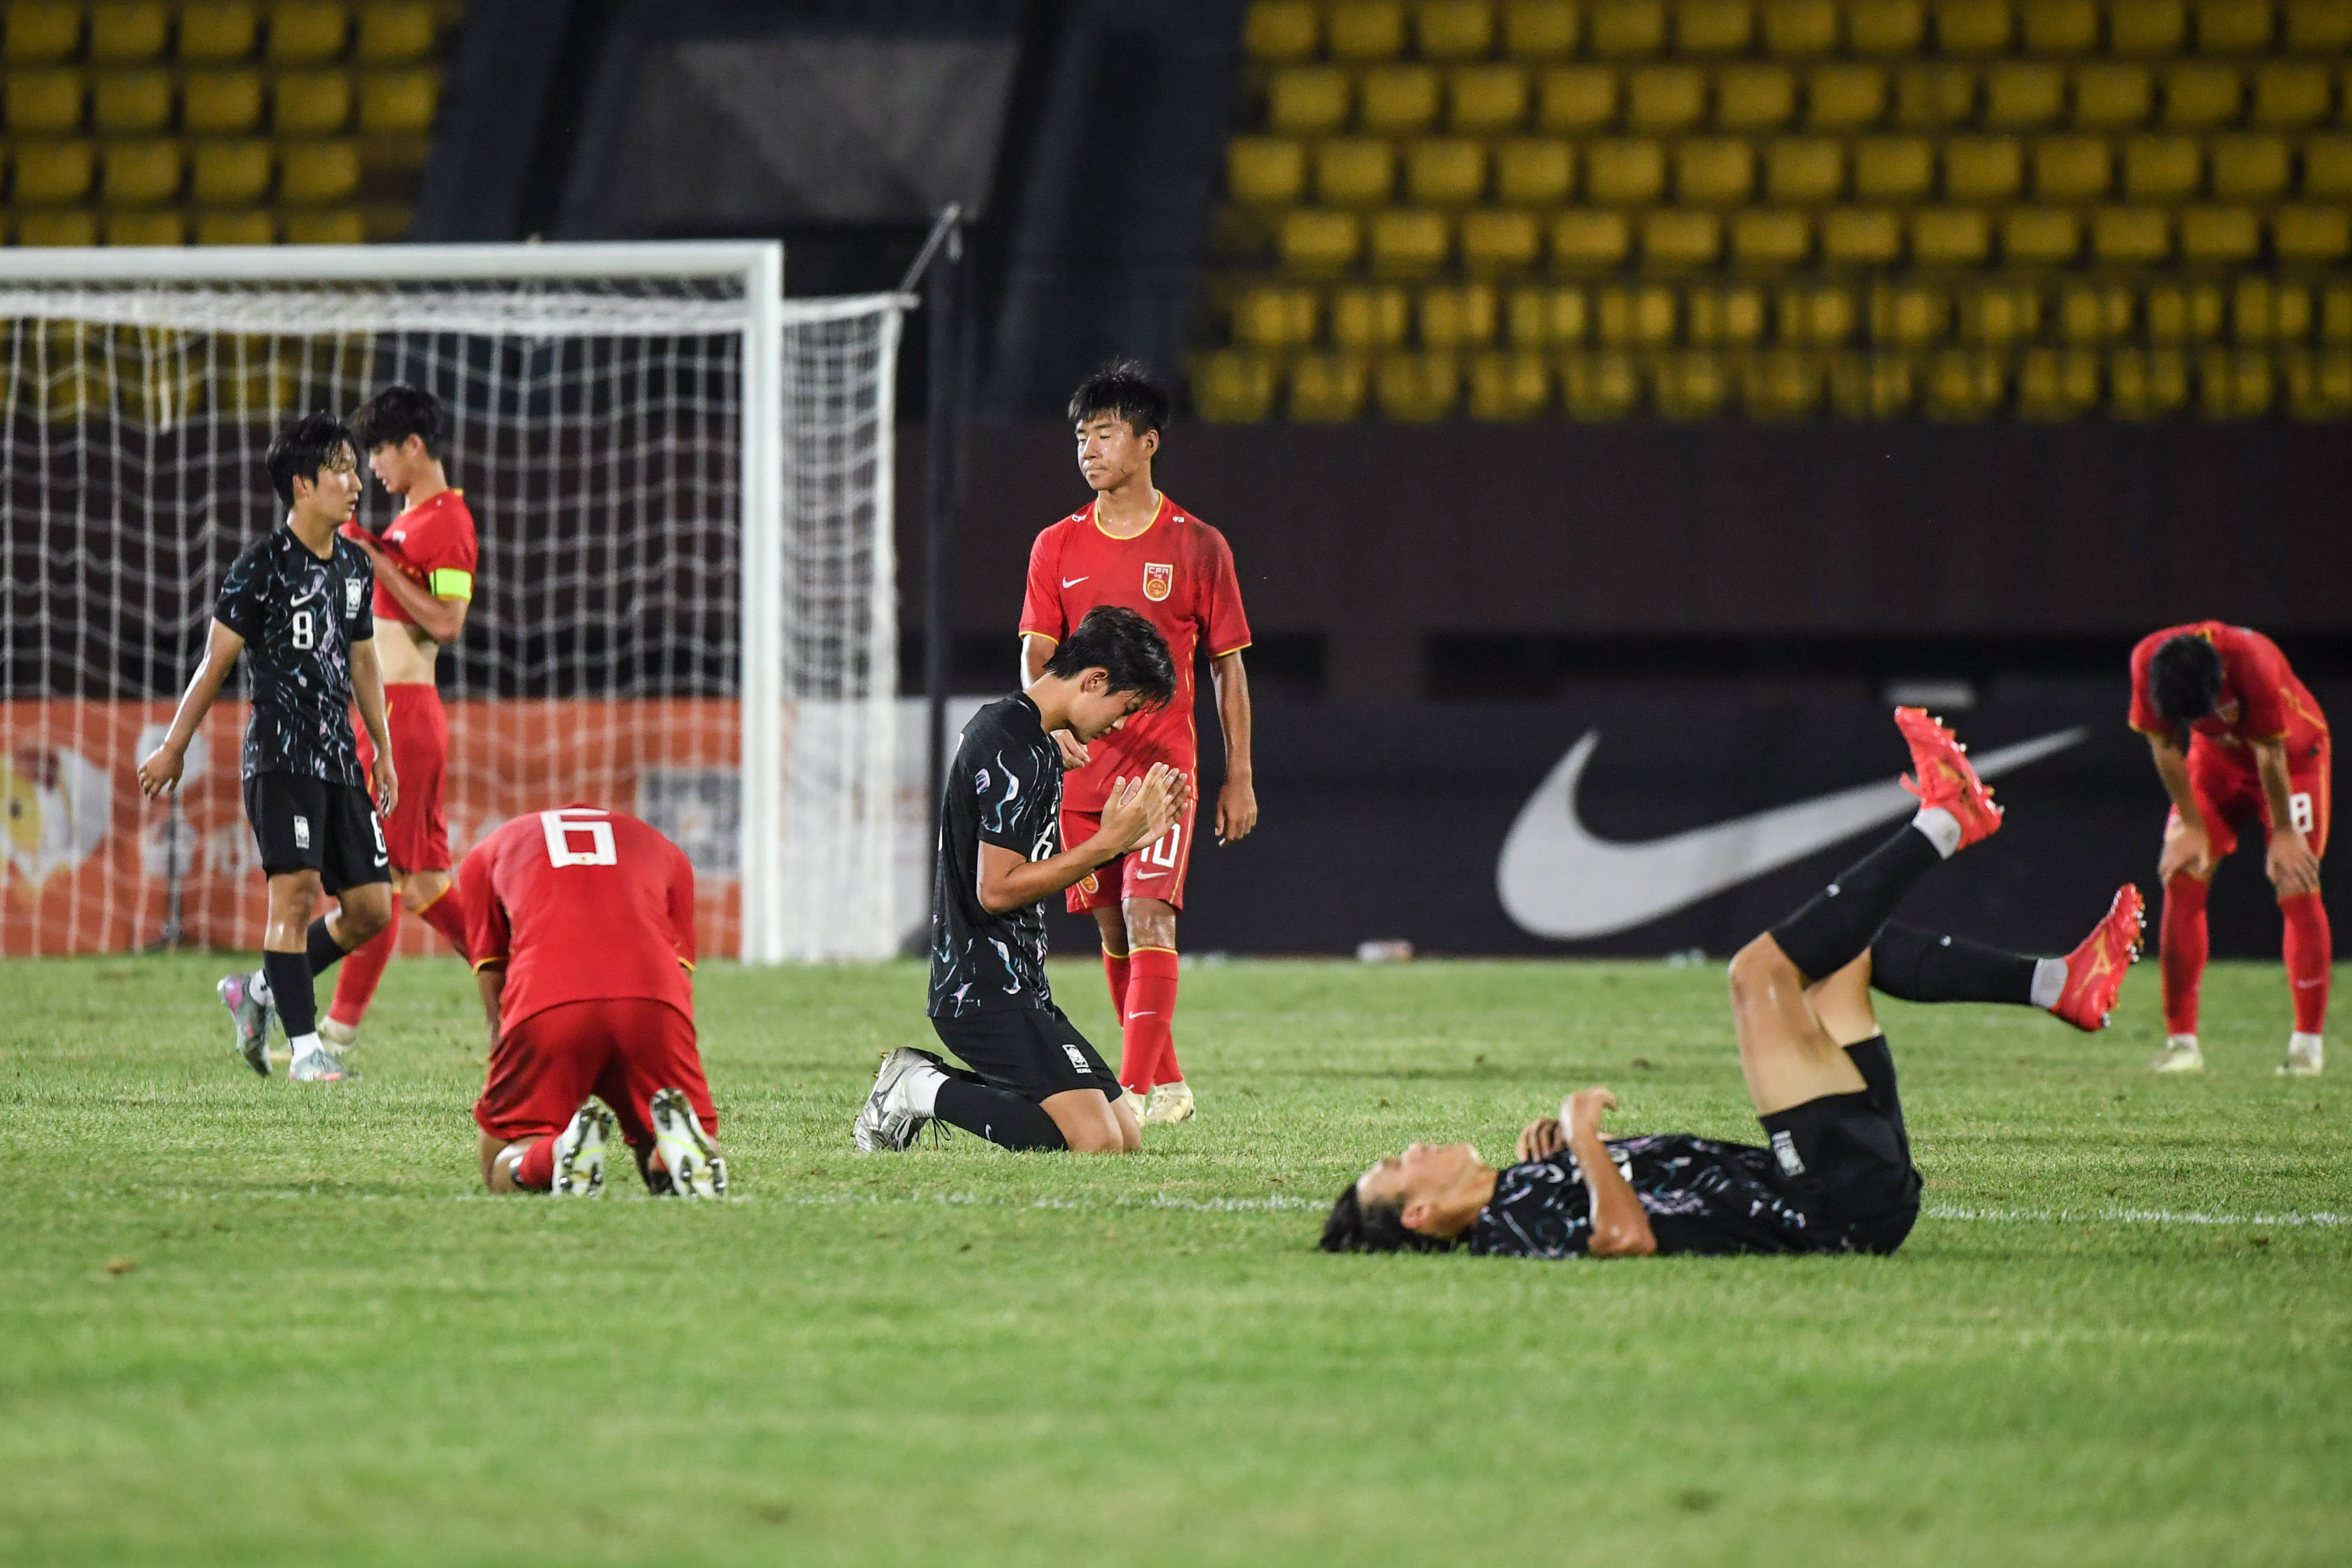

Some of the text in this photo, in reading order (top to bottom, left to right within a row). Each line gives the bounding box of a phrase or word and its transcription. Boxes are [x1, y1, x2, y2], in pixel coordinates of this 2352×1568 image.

[1149, 567, 1168, 575] CFA
[292, 611, 313, 649] 8
[541, 808, 617, 868] 6
